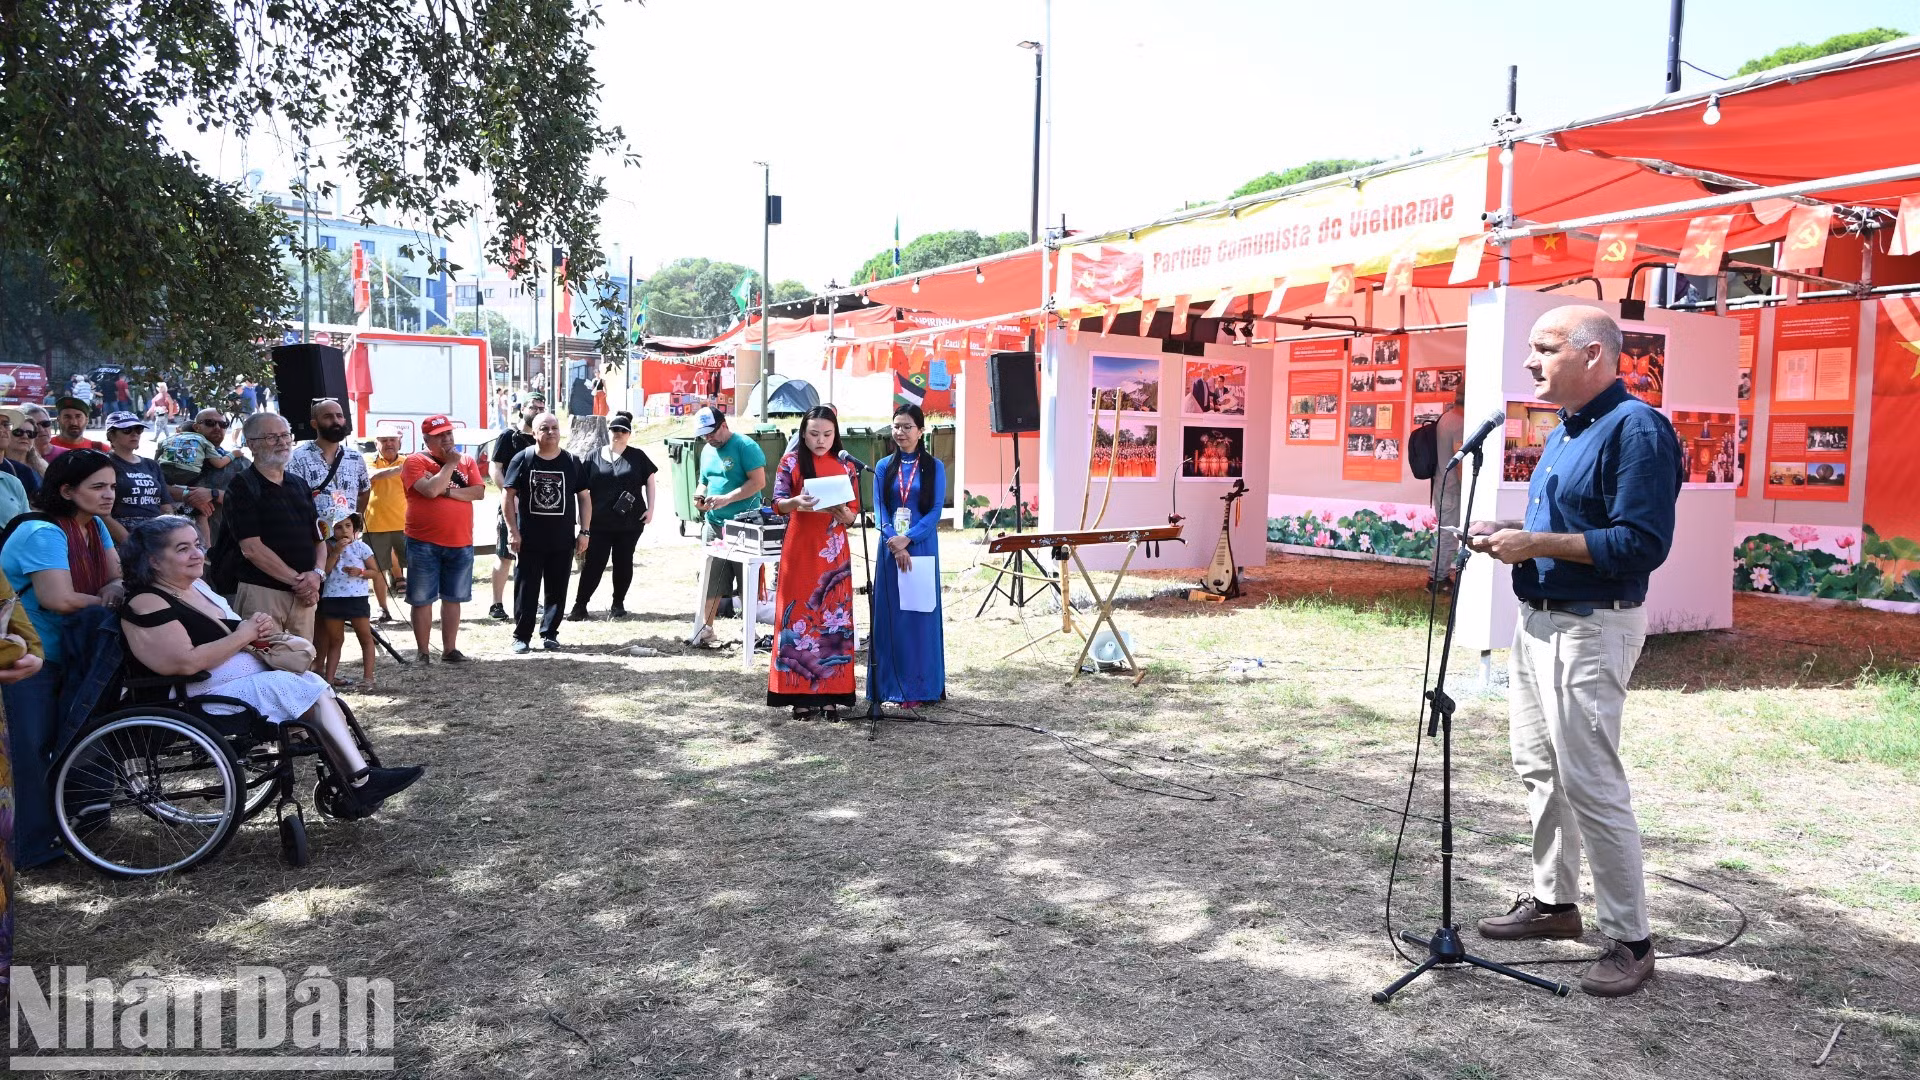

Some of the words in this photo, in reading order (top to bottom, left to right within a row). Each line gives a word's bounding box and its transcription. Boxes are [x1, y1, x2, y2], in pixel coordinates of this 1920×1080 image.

[1153, 245, 1211, 274] Partido
[1217, 224, 1311, 263] Comunista
[1318, 217, 1342, 244] do
[1350, 194, 1454, 238] Vietname
[134, 479, 155, 487] KIDS
[131, 487, 141, 495] IS
[144, 487, 158, 495] NOT
[121, 496, 138, 505] SELF
